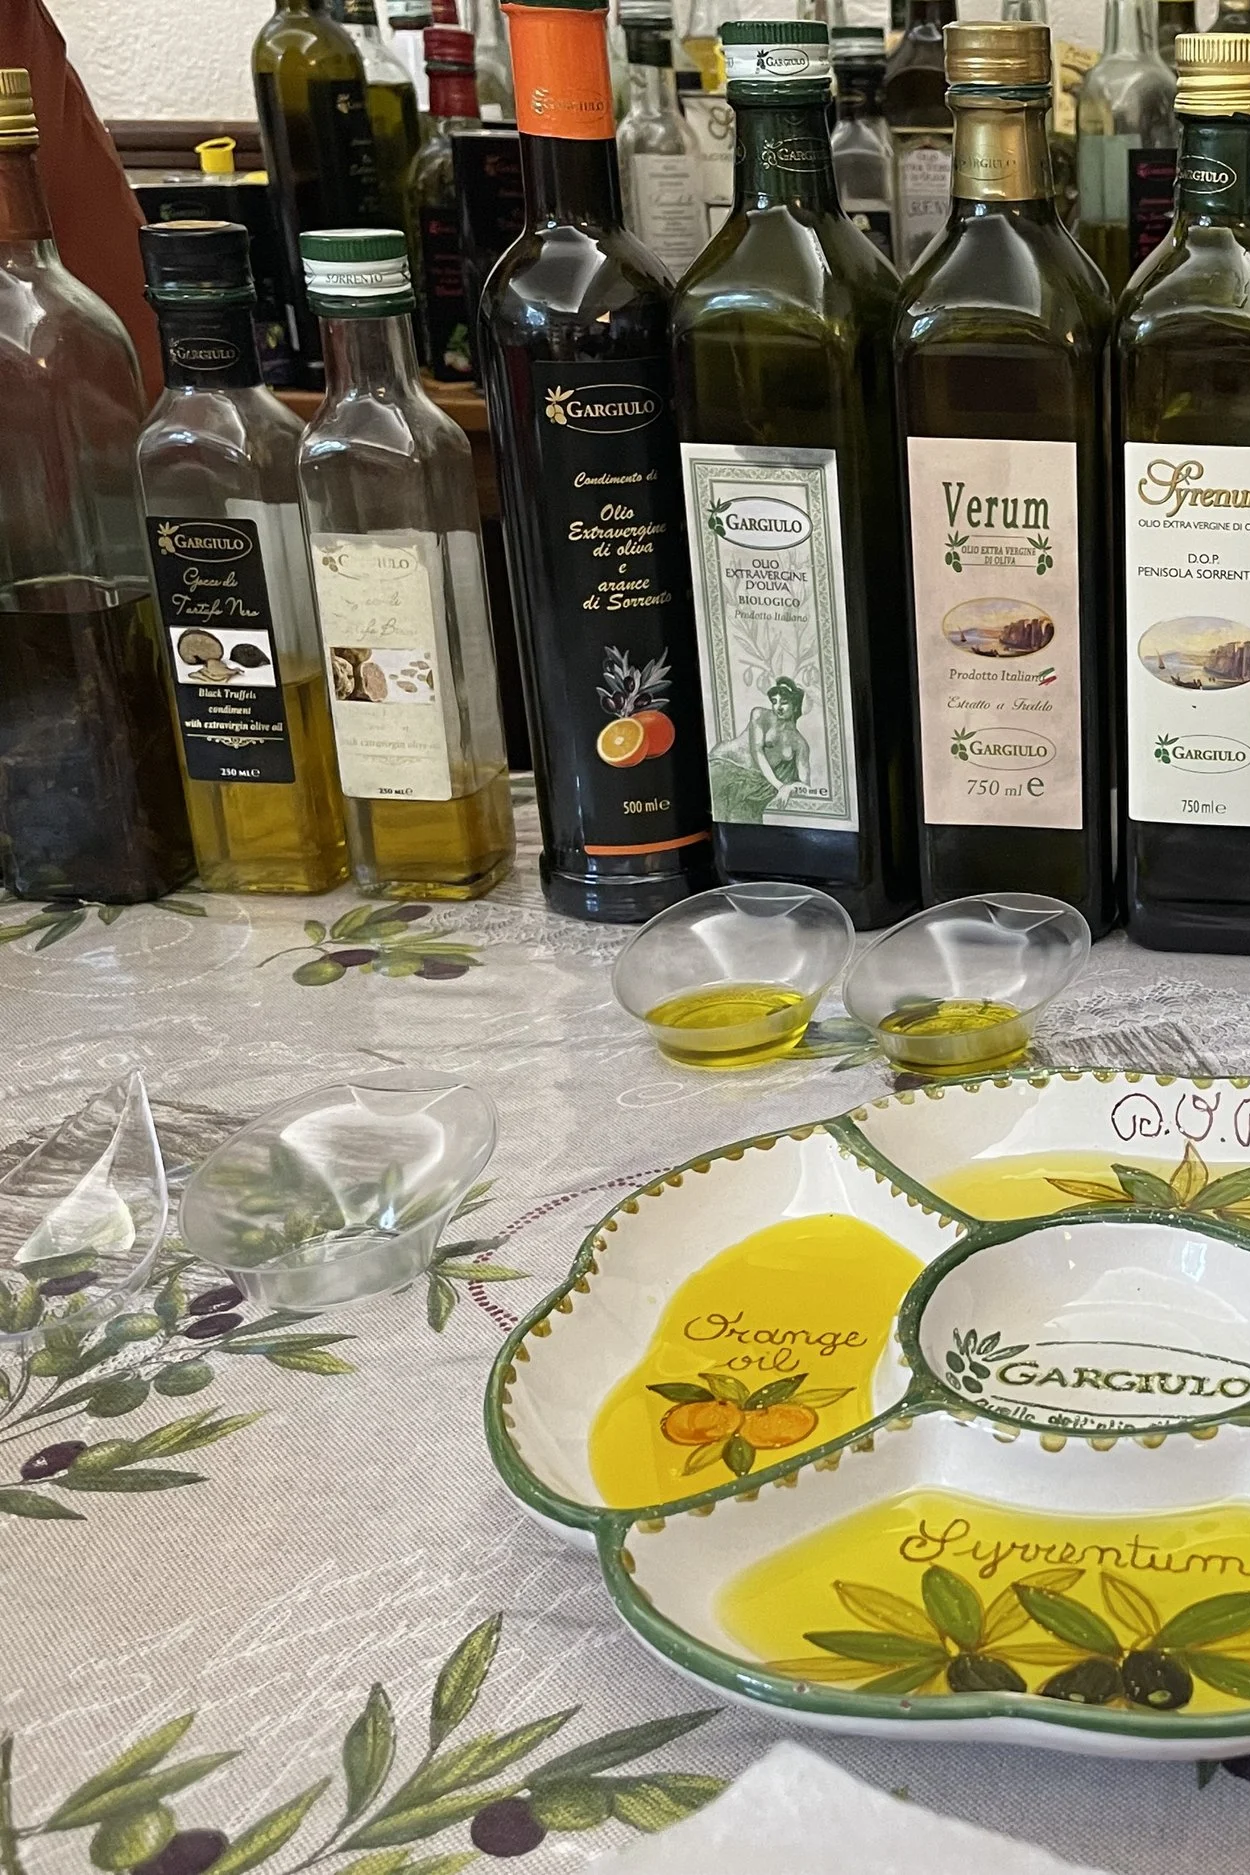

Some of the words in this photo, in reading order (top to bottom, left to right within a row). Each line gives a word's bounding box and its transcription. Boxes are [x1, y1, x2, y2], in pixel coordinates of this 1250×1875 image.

[325, 273, 383, 285] SORRENTO
[566, 399, 655, 418] GARGIULO
[574, 471, 643, 488] Condimento
[646, 468, 658, 481] di
[600, 503, 635, 521] Olio
[942, 481, 1050, 530] Verum
[725, 513, 803, 534] GARGIULO
[1138, 518, 1161, 528] OLIO
[1163, 520, 1192, 530] EXTRA
[1193, 522, 1230, 531] VERGINE
[1232, 522, 1242, 531] DI
[568, 521, 667, 542] Extravergine
[174, 534, 244, 550] GARGIULO
[593, 542, 611, 557] di
[616, 540, 654, 556] oliva
[961, 545, 979, 555] OLIO
[980, 546, 1004, 556] EXTRA
[1005, 546, 1037, 556] VERGINE
[752, 558, 780, 570] OLIO
[984, 556, 993, 565] DI
[994, 556, 1016, 566] OLIVA
[1187, 553, 1220, 565] D.O.P.
[618, 563, 627, 574] e
[725, 568, 808, 583] EXTRAVERGINE
[1137, 566, 1193, 579] PENISOLA
[223, 571, 238, 587] di
[598, 578, 650, 593] arance
[745, 579, 792, 593] D'OLIVA
[225, 597, 260, 617] Nero
[582, 595, 600, 610] di
[606, 591, 672, 611] Sorrento
[738, 595, 801, 608] BIOLOGICO
[734, 609, 772, 622] Prodotto
[949, 668, 998, 681] Prodotto
[198, 687, 222, 698] Black
[208, 705, 251, 715] condiment
[947, 695, 991, 710] Estratto
[185, 719, 202, 729] with
[204, 720, 248, 732] extravirgin
[250, 721, 270, 732] olive
[271, 722, 283, 732] oil
[969, 740, 1048, 758] GARGIULO
[1172, 746, 1246, 762] GARGIULO
[220, 767, 237, 776] 250
[379, 786, 393, 795] 250
[967, 779, 1000, 796] 750
[1004, 784, 1022, 797] ml
[623, 800, 643, 815] 500
[1181, 799, 1200, 813] 750
[683, 1311, 868, 1356] Orange
[712, 1347, 800, 1372] oil
